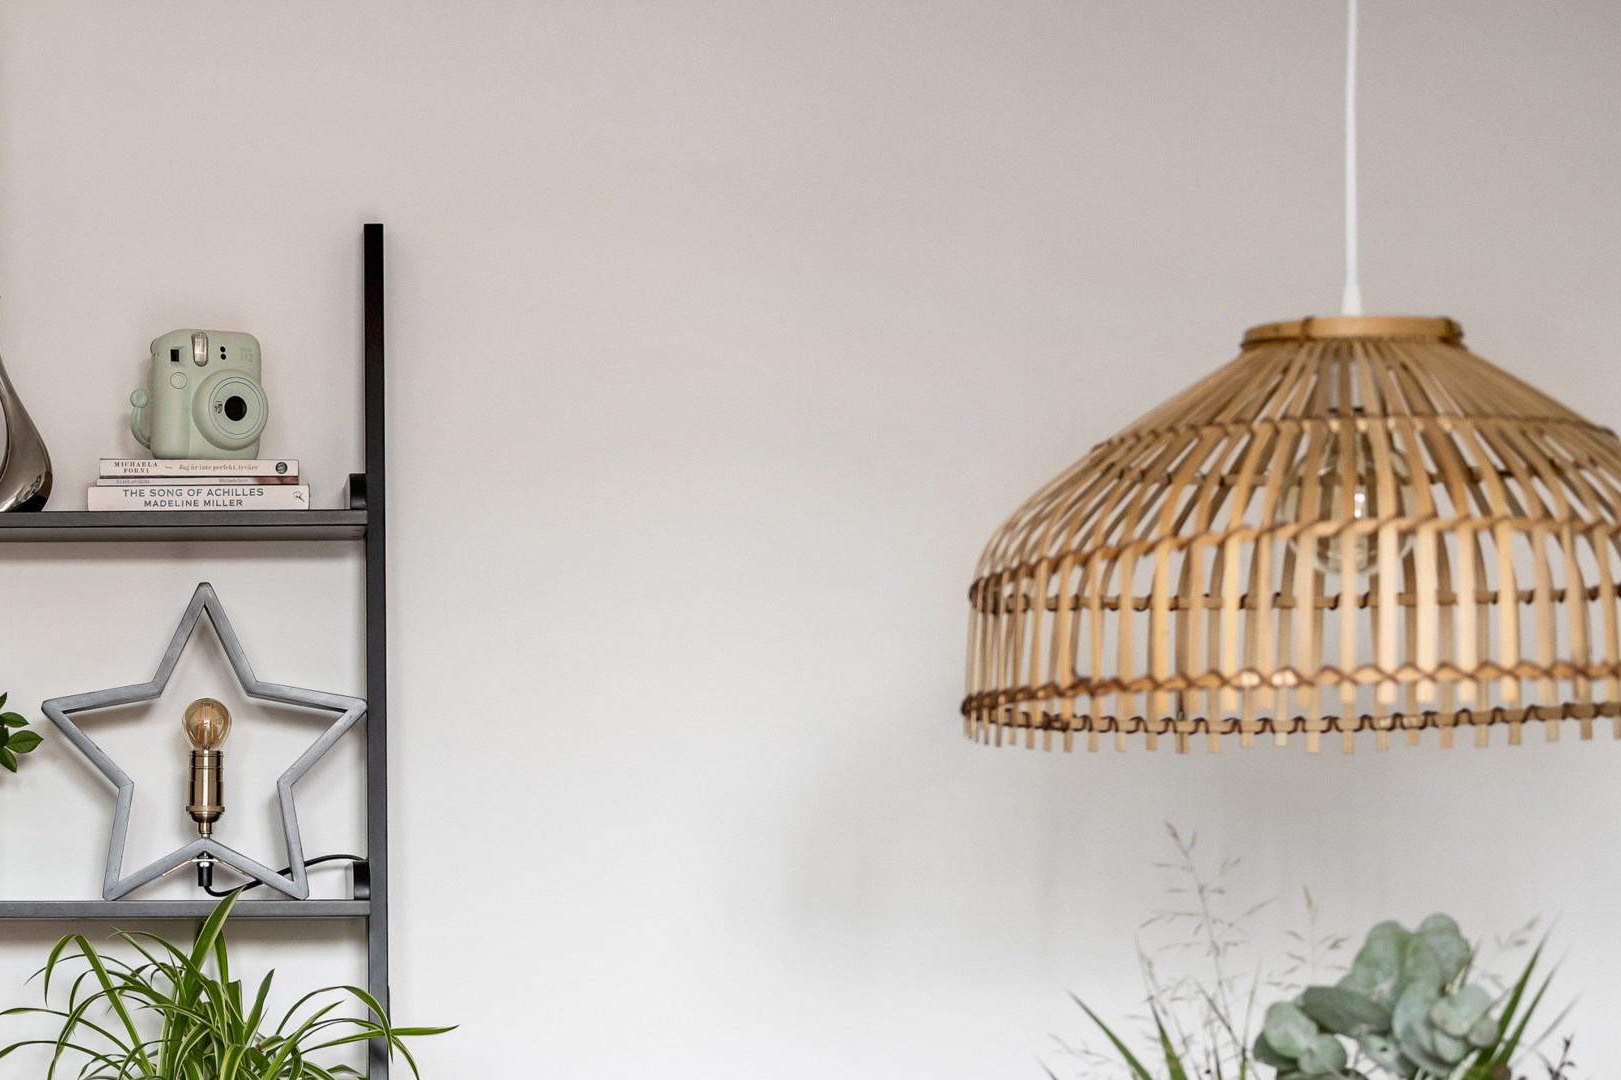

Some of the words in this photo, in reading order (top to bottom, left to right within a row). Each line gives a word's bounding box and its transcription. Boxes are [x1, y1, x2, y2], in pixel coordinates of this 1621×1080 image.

[123, 489, 146, 497] THE
[149, 489, 183, 497] SONG
[187, 488, 203, 497] OF
[206, 488, 264, 497] ACHILLES
[144, 499, 199, 507] MADELINE
[203, 499, 243, 507] MILLER
